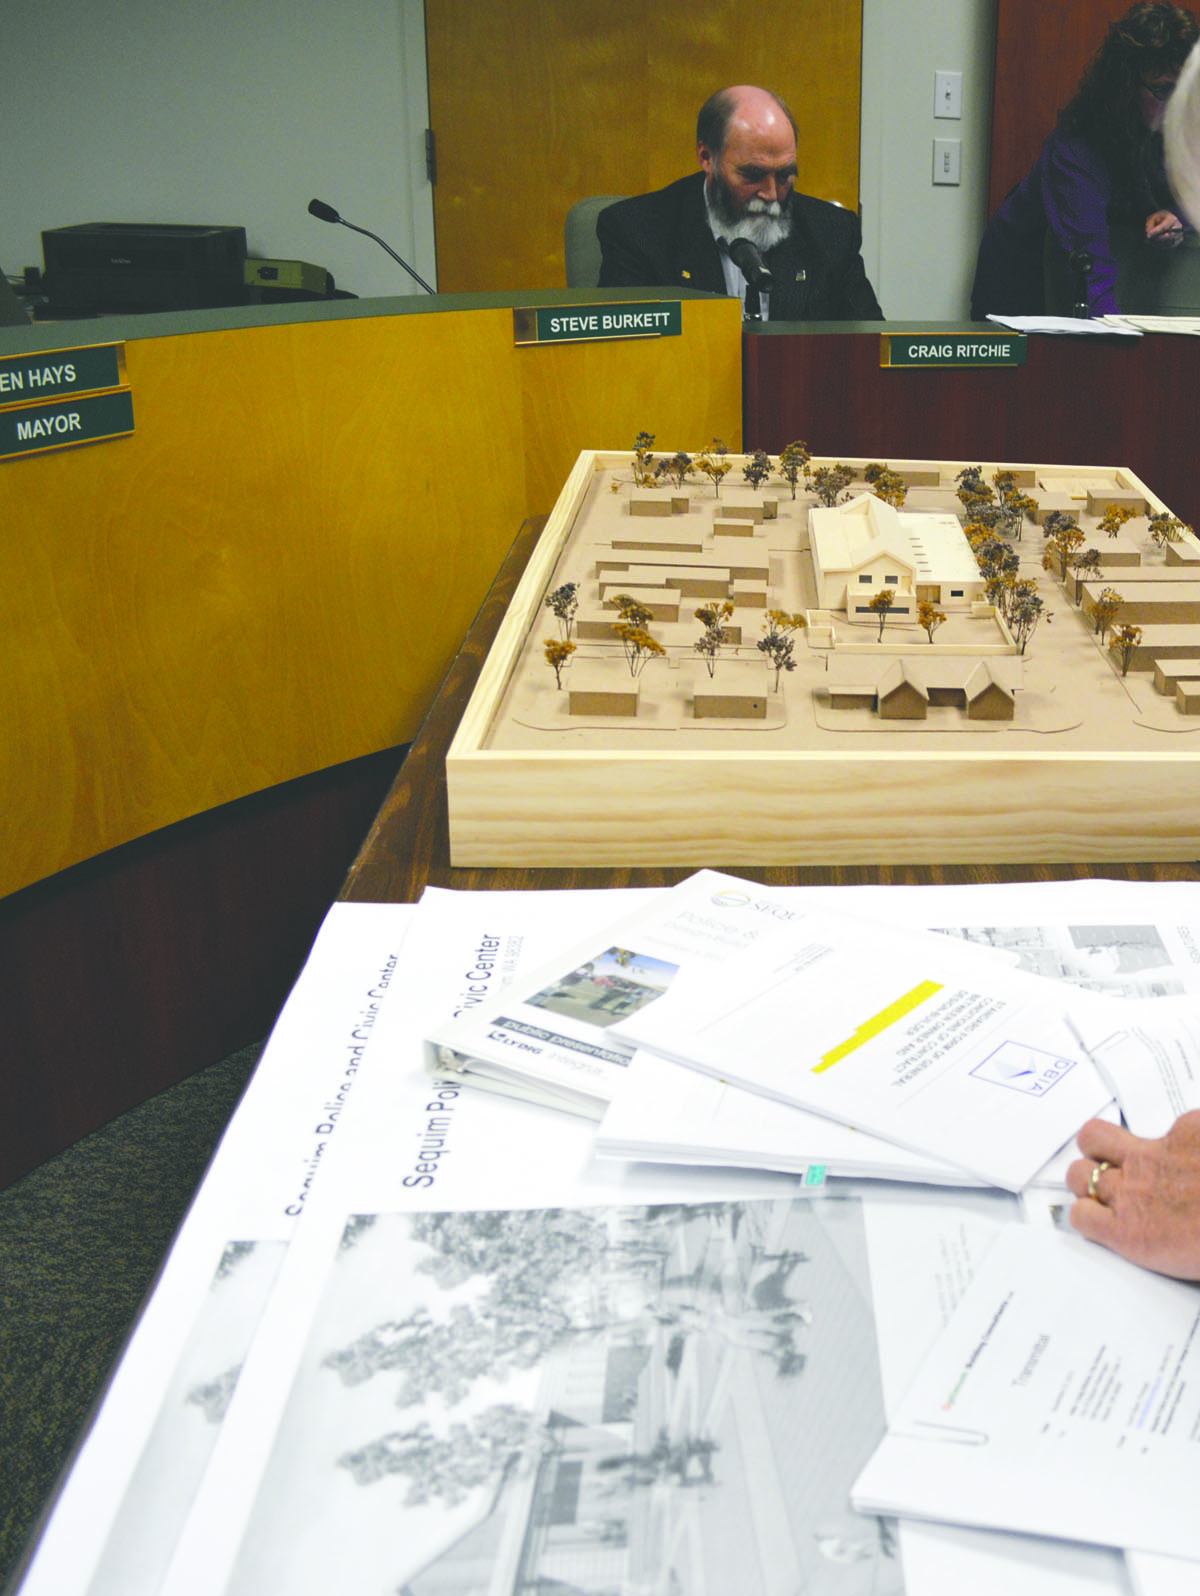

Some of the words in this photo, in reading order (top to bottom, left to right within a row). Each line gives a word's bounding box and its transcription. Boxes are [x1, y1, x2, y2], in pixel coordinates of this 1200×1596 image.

[550, 316, 598, 332] STEVE
[602, 312, 670, 329] BURKETT
[908, 345, 953, 358] CRAIG
[956, 344, 1011, 358] RITCHIE
[0, 371, 24, 392] EN
[28, 364, 77, 388] HAYS
[17, 412, 82, 441] MAYOR
[465, 934, 501, 981] Center
[550, 1034, 632, 1068] presentatio
[1032, 1059, 1070, 1090] DBIA
[426, 1080, 462, 1112] Poli
[402, 1117, 452, 1188] Sequim
